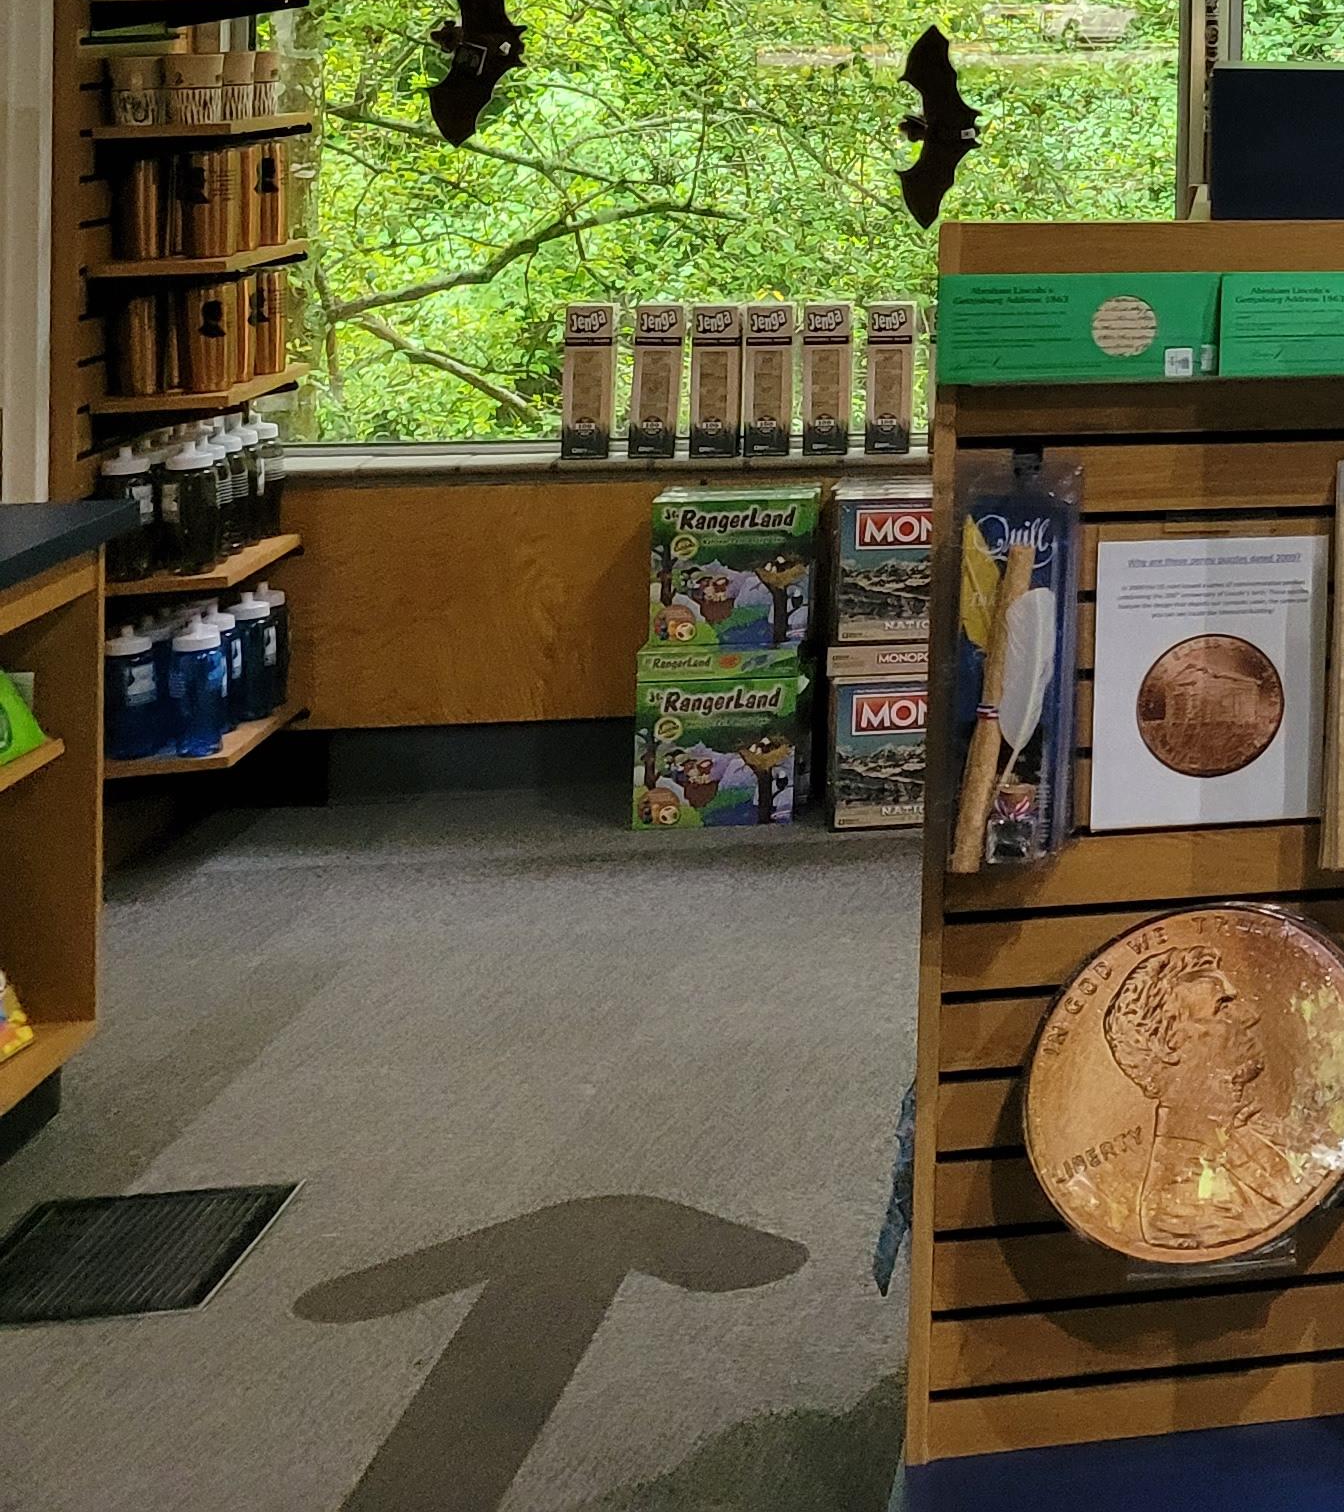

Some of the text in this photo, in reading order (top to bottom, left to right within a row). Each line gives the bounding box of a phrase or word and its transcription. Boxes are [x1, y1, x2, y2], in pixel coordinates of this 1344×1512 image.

[570, 309, 608, 333] Jenga
[640, 308, 678, 332] Jenga
[697, 310, 733, 333] Jenga
[751, 309, 786, 333] Jenga
[807, 308, 843, 332] Jenga
[871, 308, 907, 332] Jenga
[679, 504, 797, 535] RangerLand
[663, 687, 782, 716] RangerLand
[1064, 960, 1113, 1016] GOD
[1126, 926, 1169, 956] WE
[1053, 1125, 1144, 1185] LIBERTY
